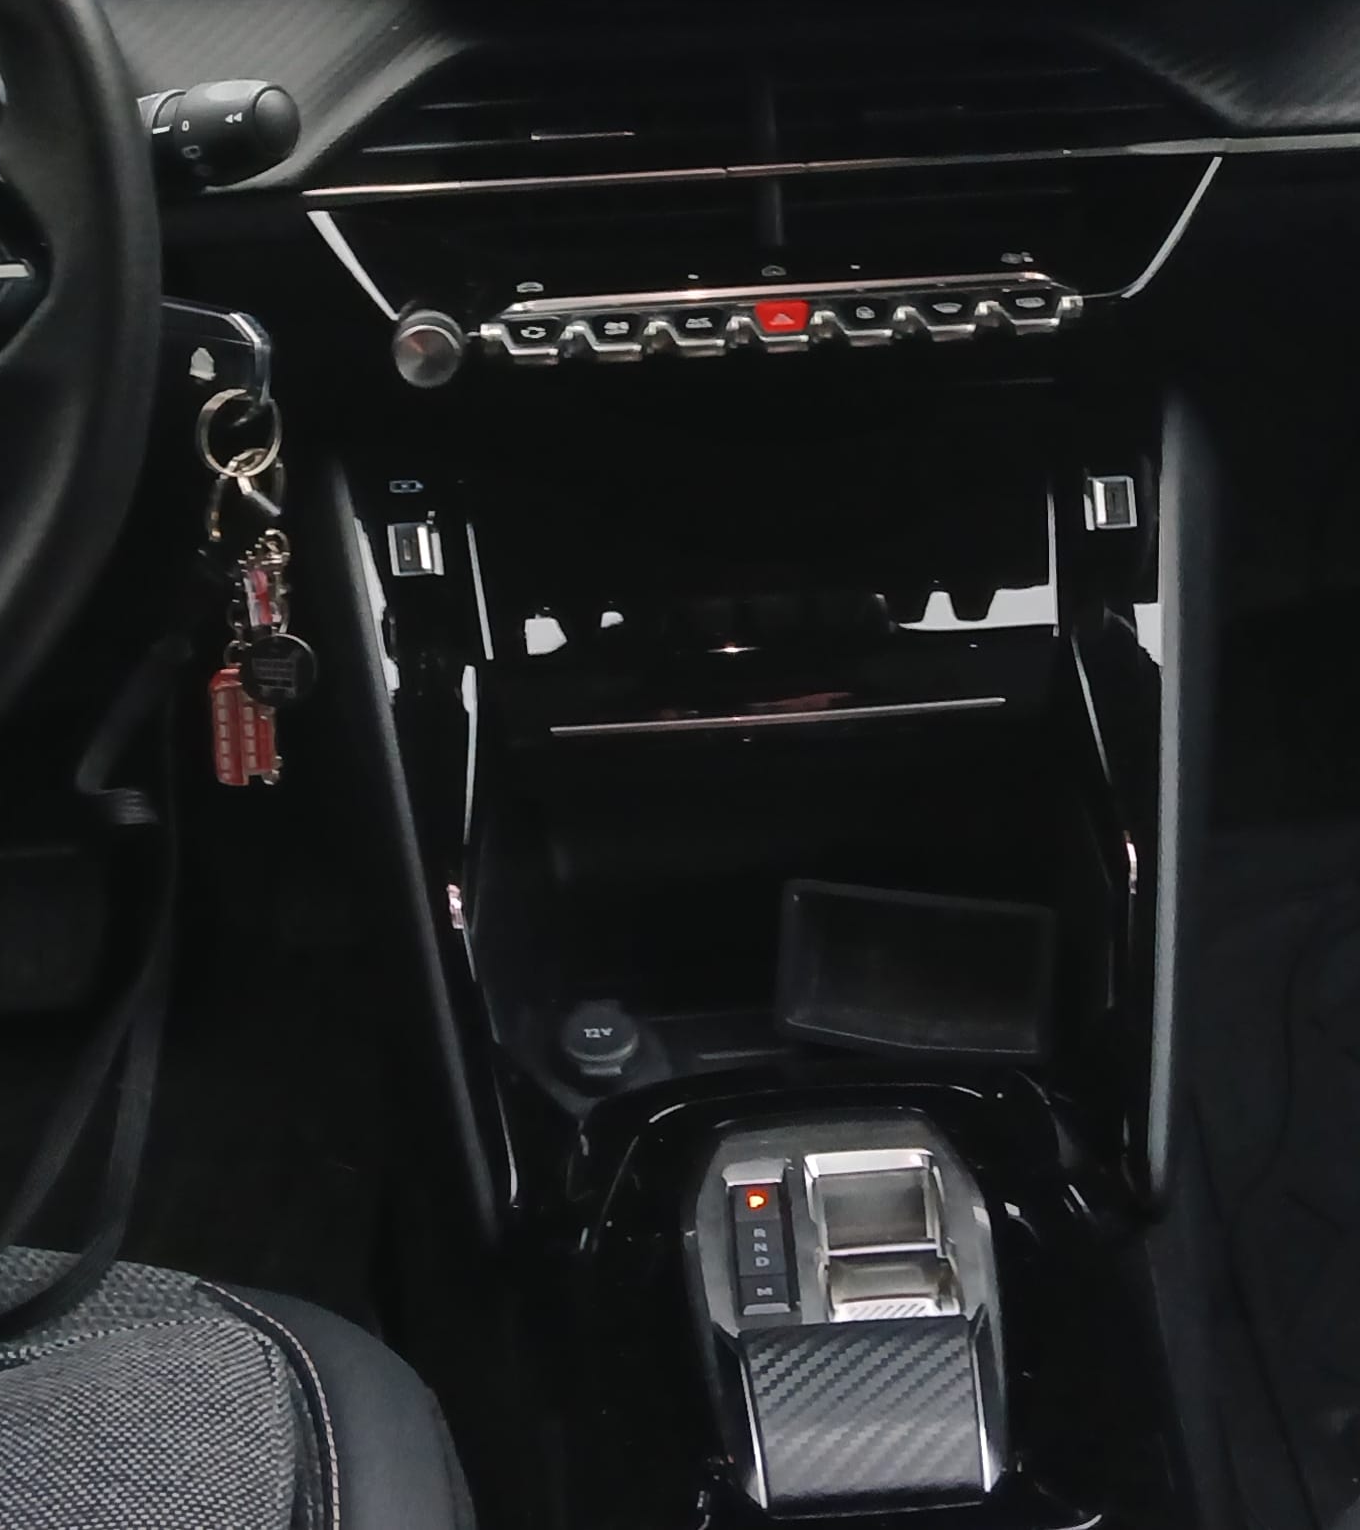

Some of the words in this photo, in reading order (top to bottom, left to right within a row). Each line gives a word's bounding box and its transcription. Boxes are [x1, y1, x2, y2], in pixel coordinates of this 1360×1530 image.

[748, 1195, 765, 1208] P
[753, 1242, 768, 1253] N
[755, 1256, 770, 1267] D
